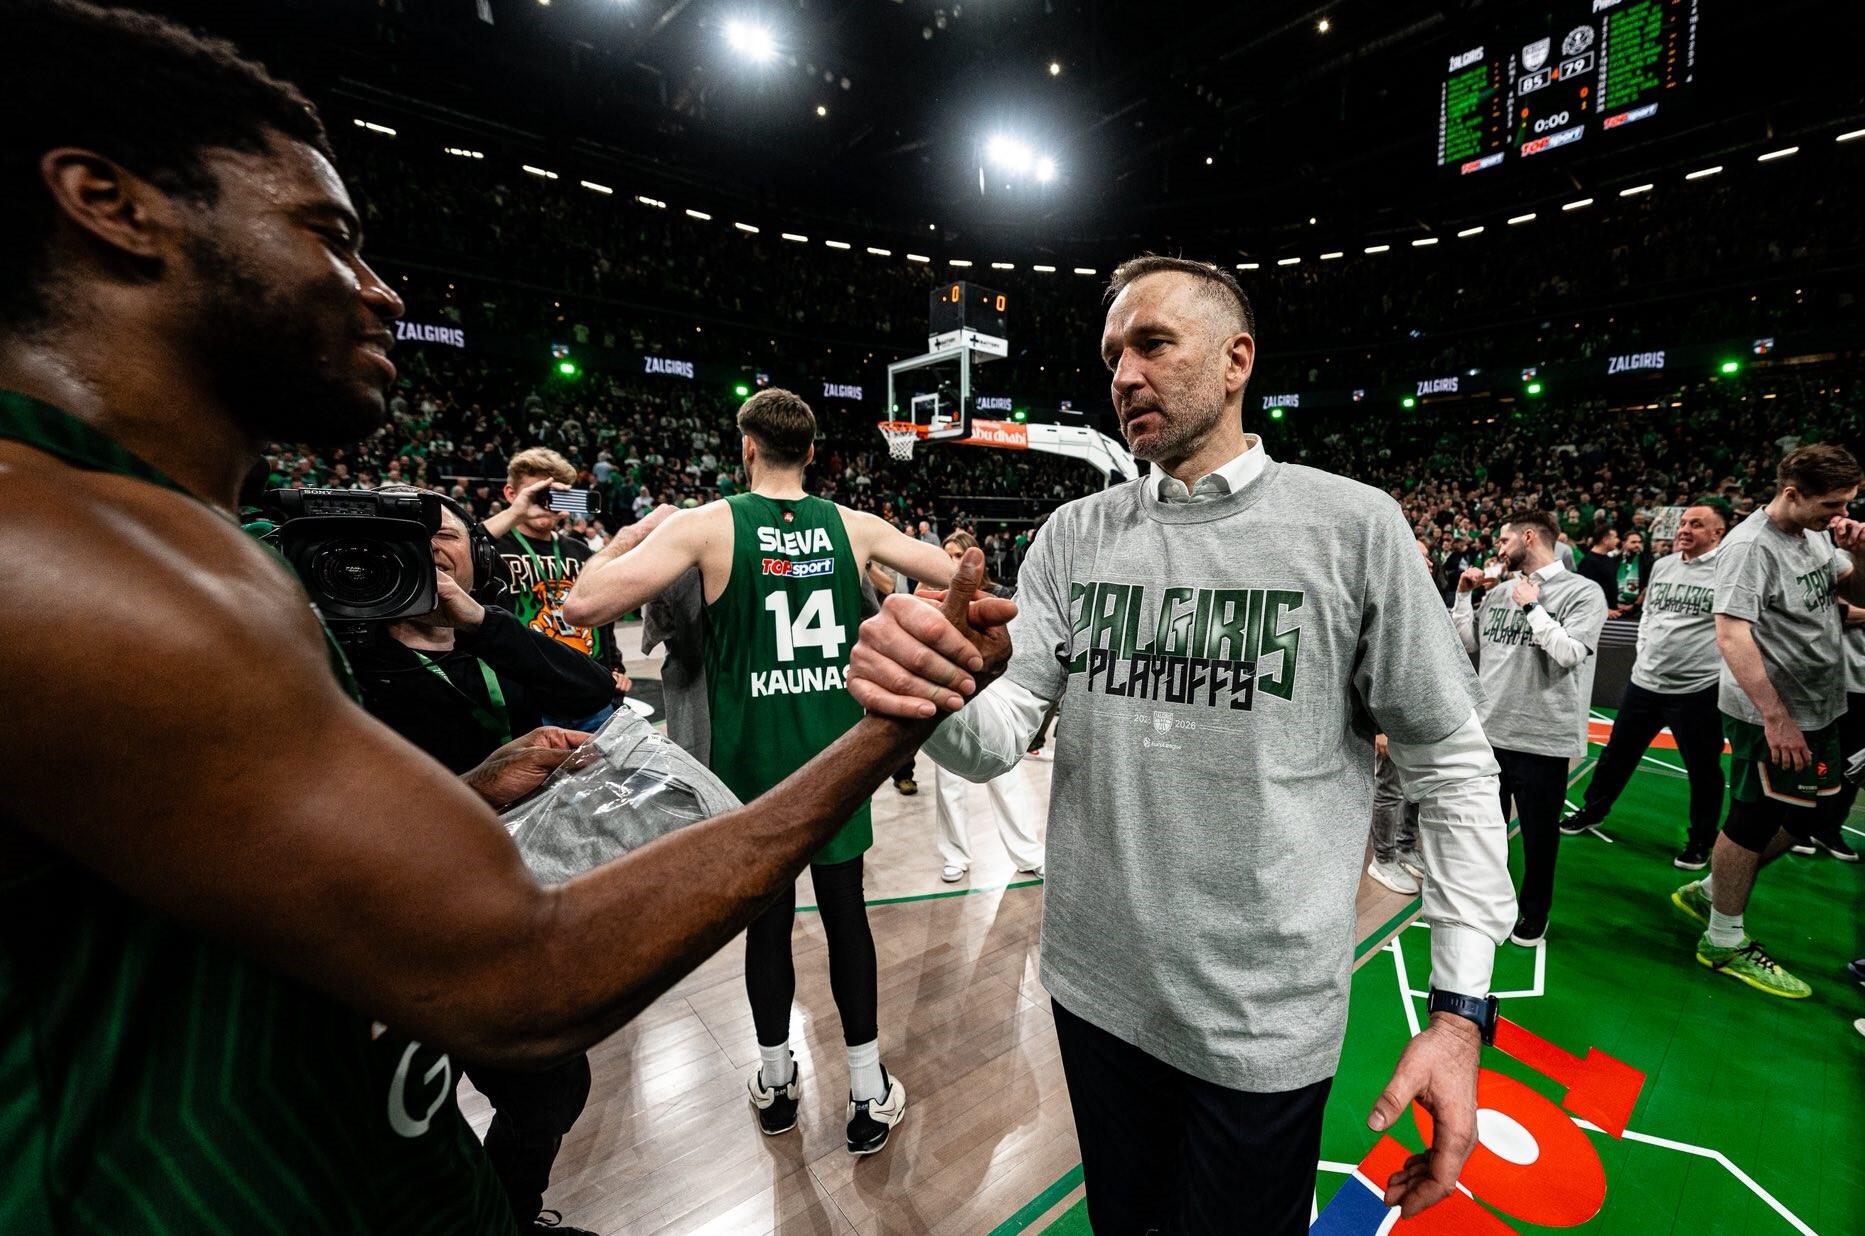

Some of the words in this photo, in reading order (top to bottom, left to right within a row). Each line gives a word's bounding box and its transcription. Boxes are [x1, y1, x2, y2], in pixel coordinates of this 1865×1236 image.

[1564, 59, 1585, 76] 79
[1523, 75, 1543, 92] 85
[1534, 111, 1569, 132] 0:00
[951, 285, 960, 302] 0
[996, 295, 1006, 311] 0
[994, 430, 1026, 445] dhabi
[757, 526, 834, 556] SLEVA
[765, 589, 846, 662] 14
[1088, 648, 1256, 711] PLAYOFFS
[1175, 719, 1197, 730] 2026
